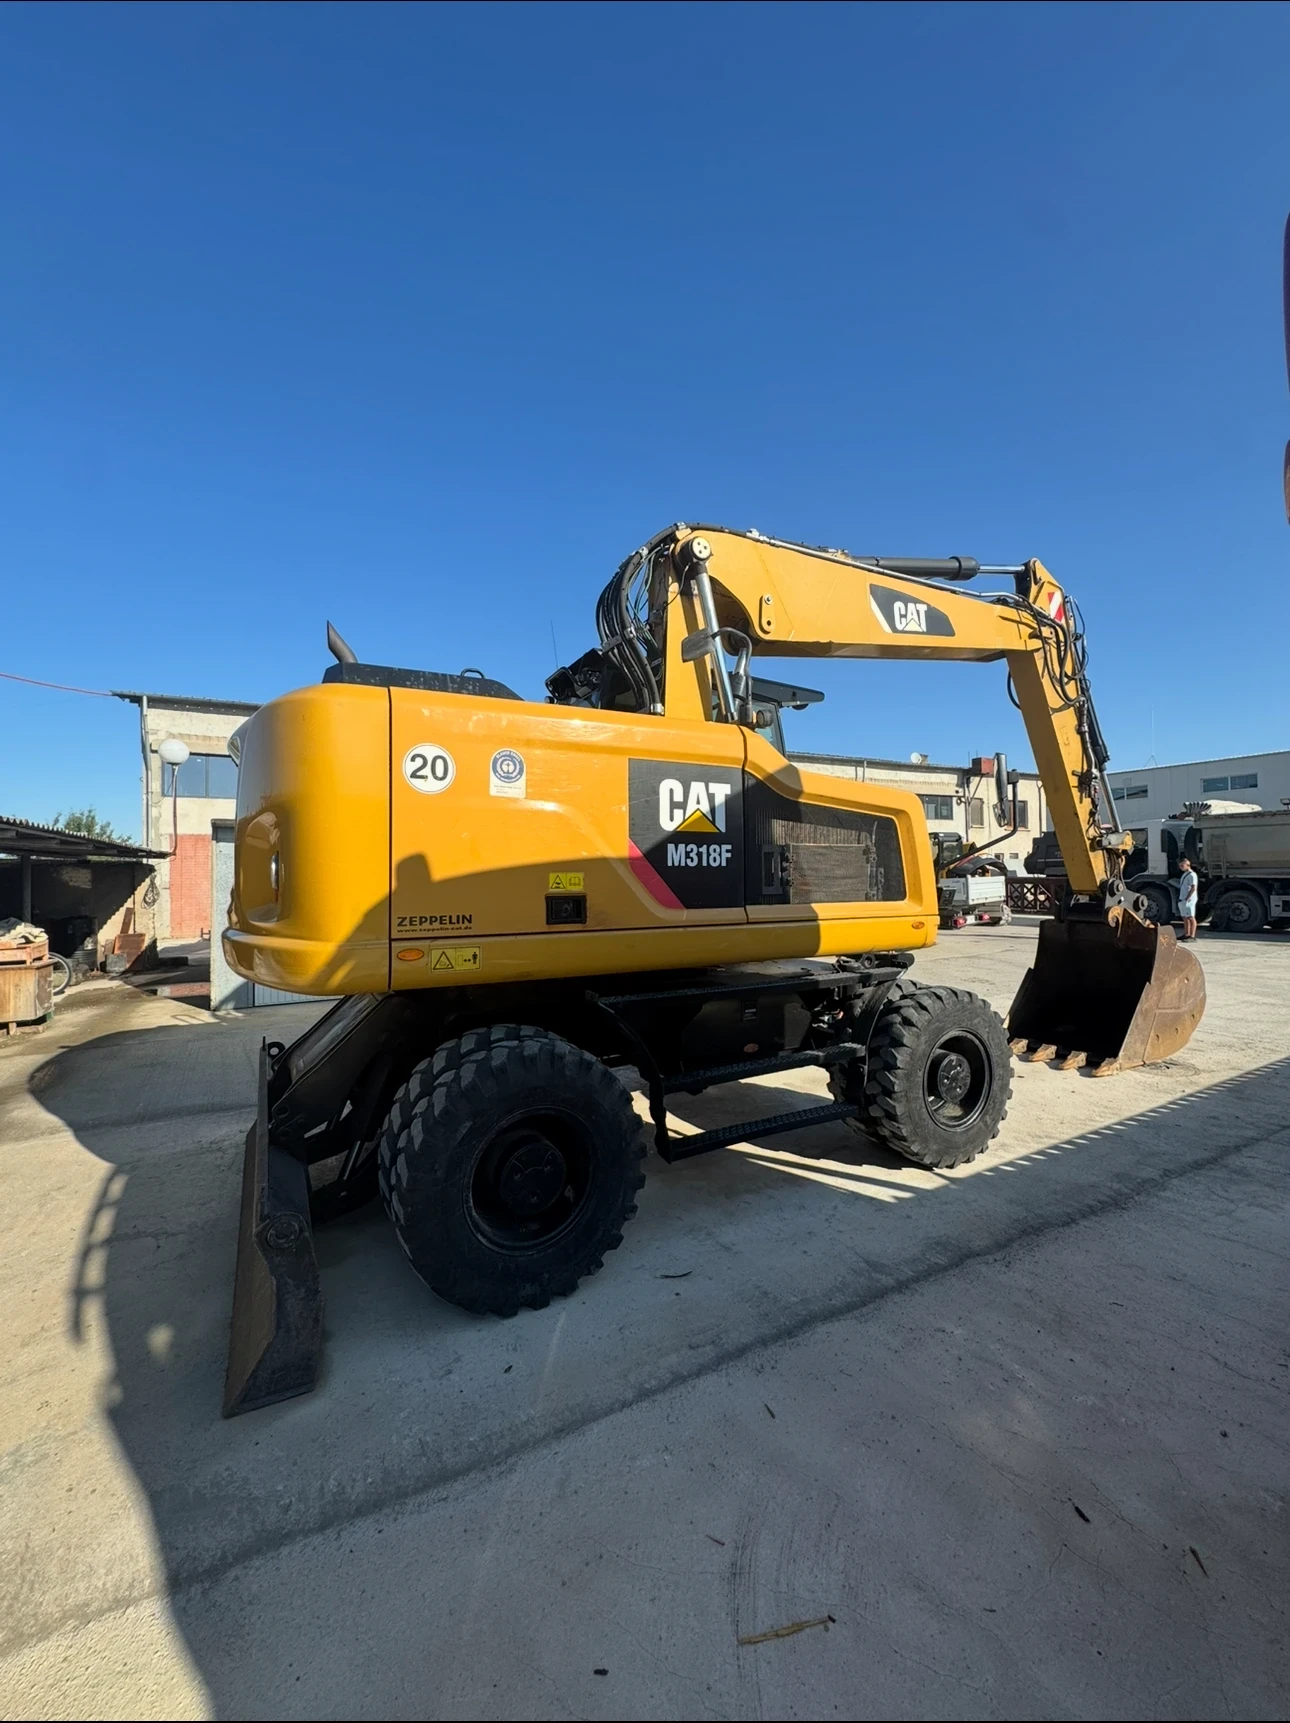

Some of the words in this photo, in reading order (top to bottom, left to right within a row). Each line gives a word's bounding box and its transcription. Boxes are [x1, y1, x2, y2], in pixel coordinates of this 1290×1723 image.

[893, 601, 928, 632] CAT
[410, 753, 449, 781] 20
[659, 778, 731, 832] CAT
[667, 843, 732, 867] M318F
[397, 914, 473, 927] ZEPPELIN
